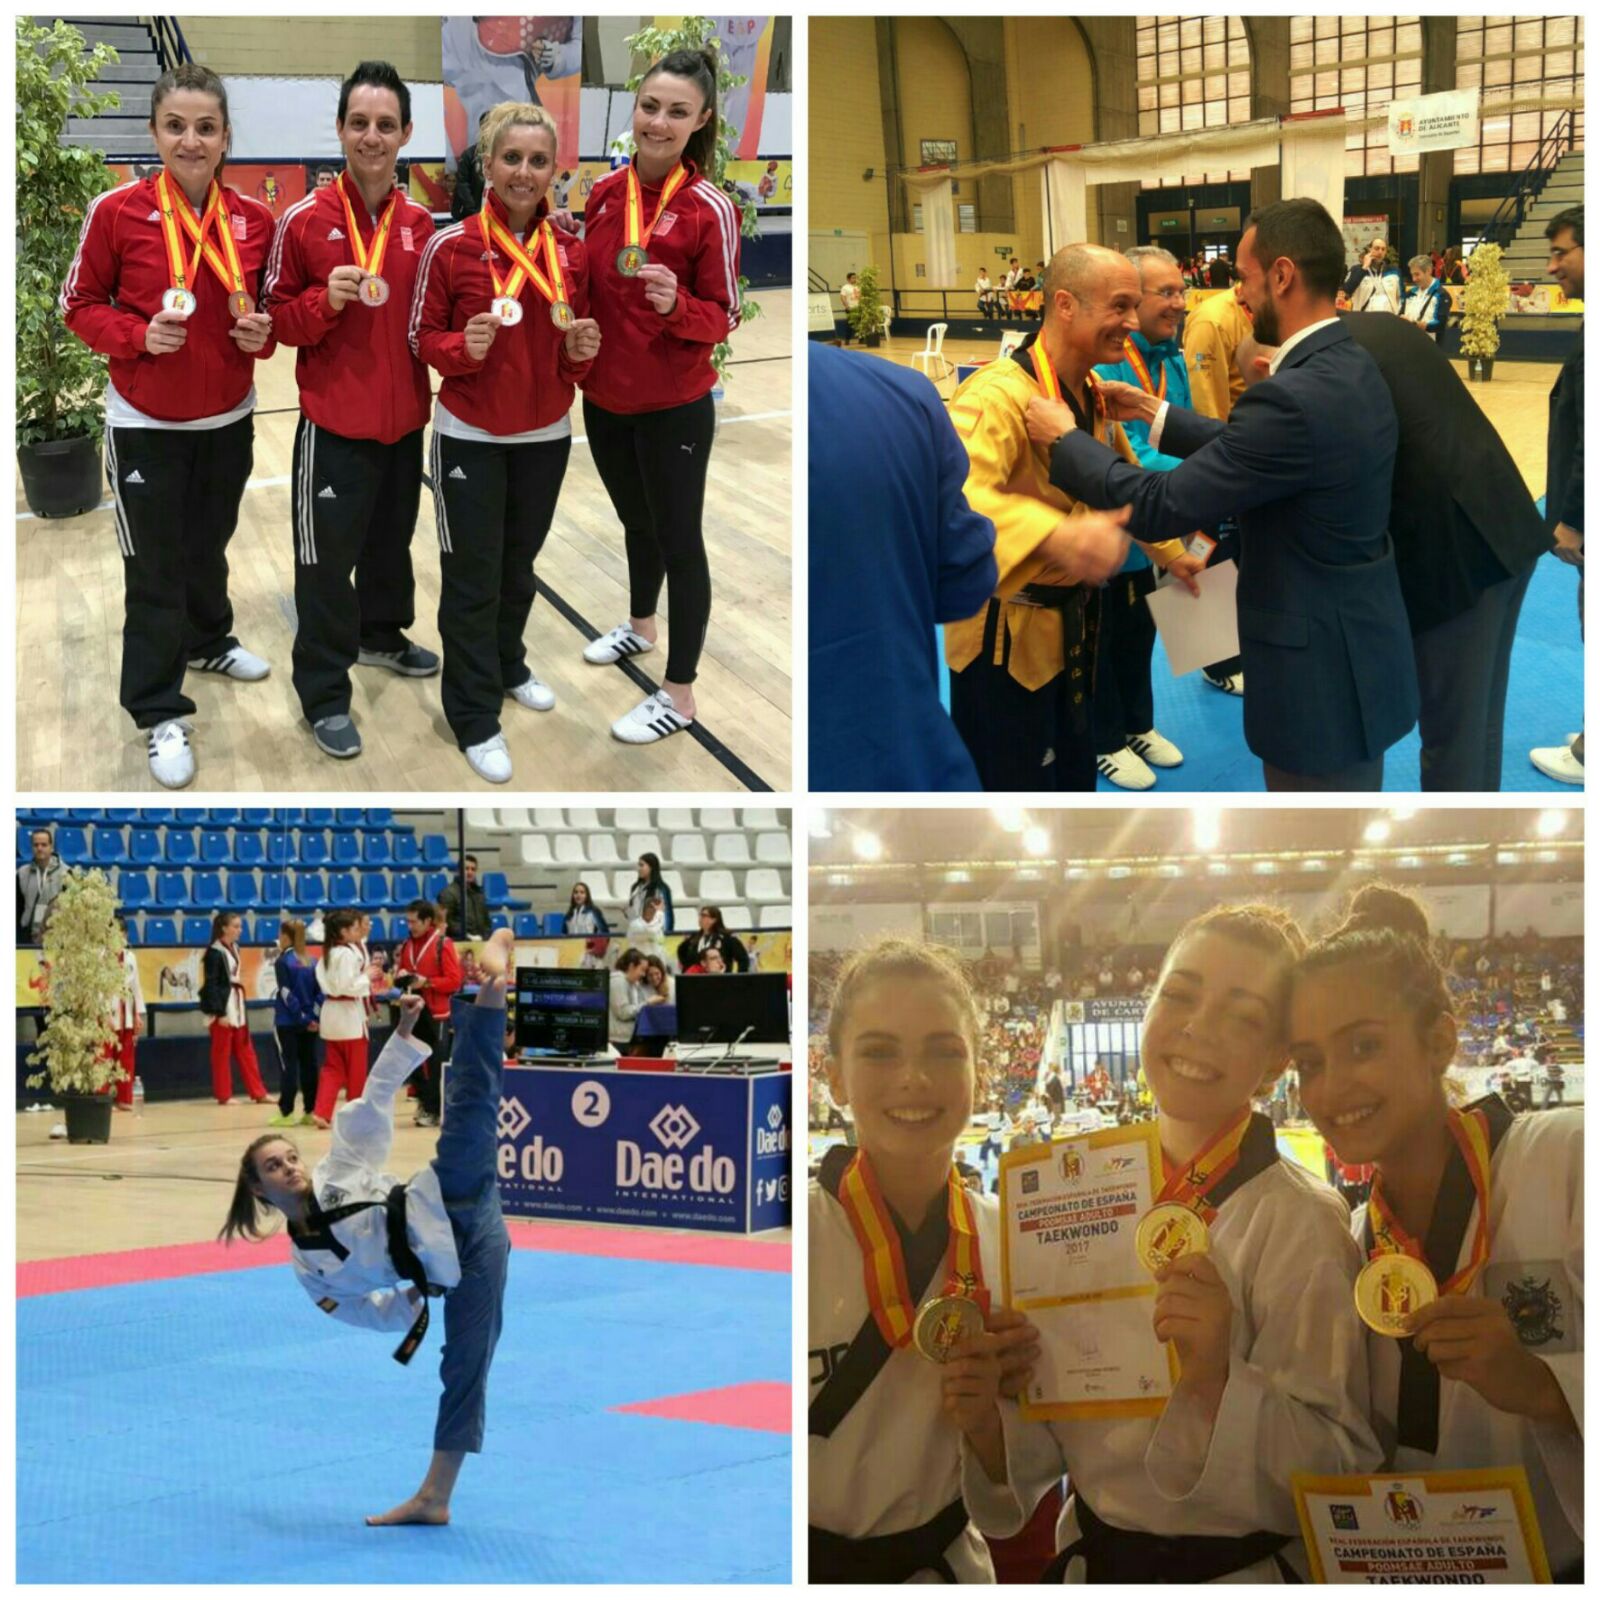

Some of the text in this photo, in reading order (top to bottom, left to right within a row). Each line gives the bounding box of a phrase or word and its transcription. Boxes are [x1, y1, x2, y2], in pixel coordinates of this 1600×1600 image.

[1419, 112, 1470, 124] AYUNTAMIENTO
[1429, 121, 1460, 130] ALICANTE
[1092, 1000, 1147, 1008] AYUNTA
[583, 1091, 600, 1116] 2
[615, 1190, 735, 1204] INTERNATIONAL
[1018, 1191, 1137, 1220] CAMPEONATO DE ESPAÑA
[596, 1206, 658, 1217] www.daedo.com
[672, 1212, 736, 1223] www.daedo.com
[1079, 1208, 1114, 1221] ADULTO
[1036, 1220, 1119, 1244] TAEKWONDO
[1065, 1241, 1090, 1255] 2017
[1334, 1543, 1507, 1559] CAMPEONATO DE ESPAÑA
[1368, 1560, 1475, 1572] POOMSAE ADULTO
[1366, 1573, 1485, 1585] TAEKWONDO
